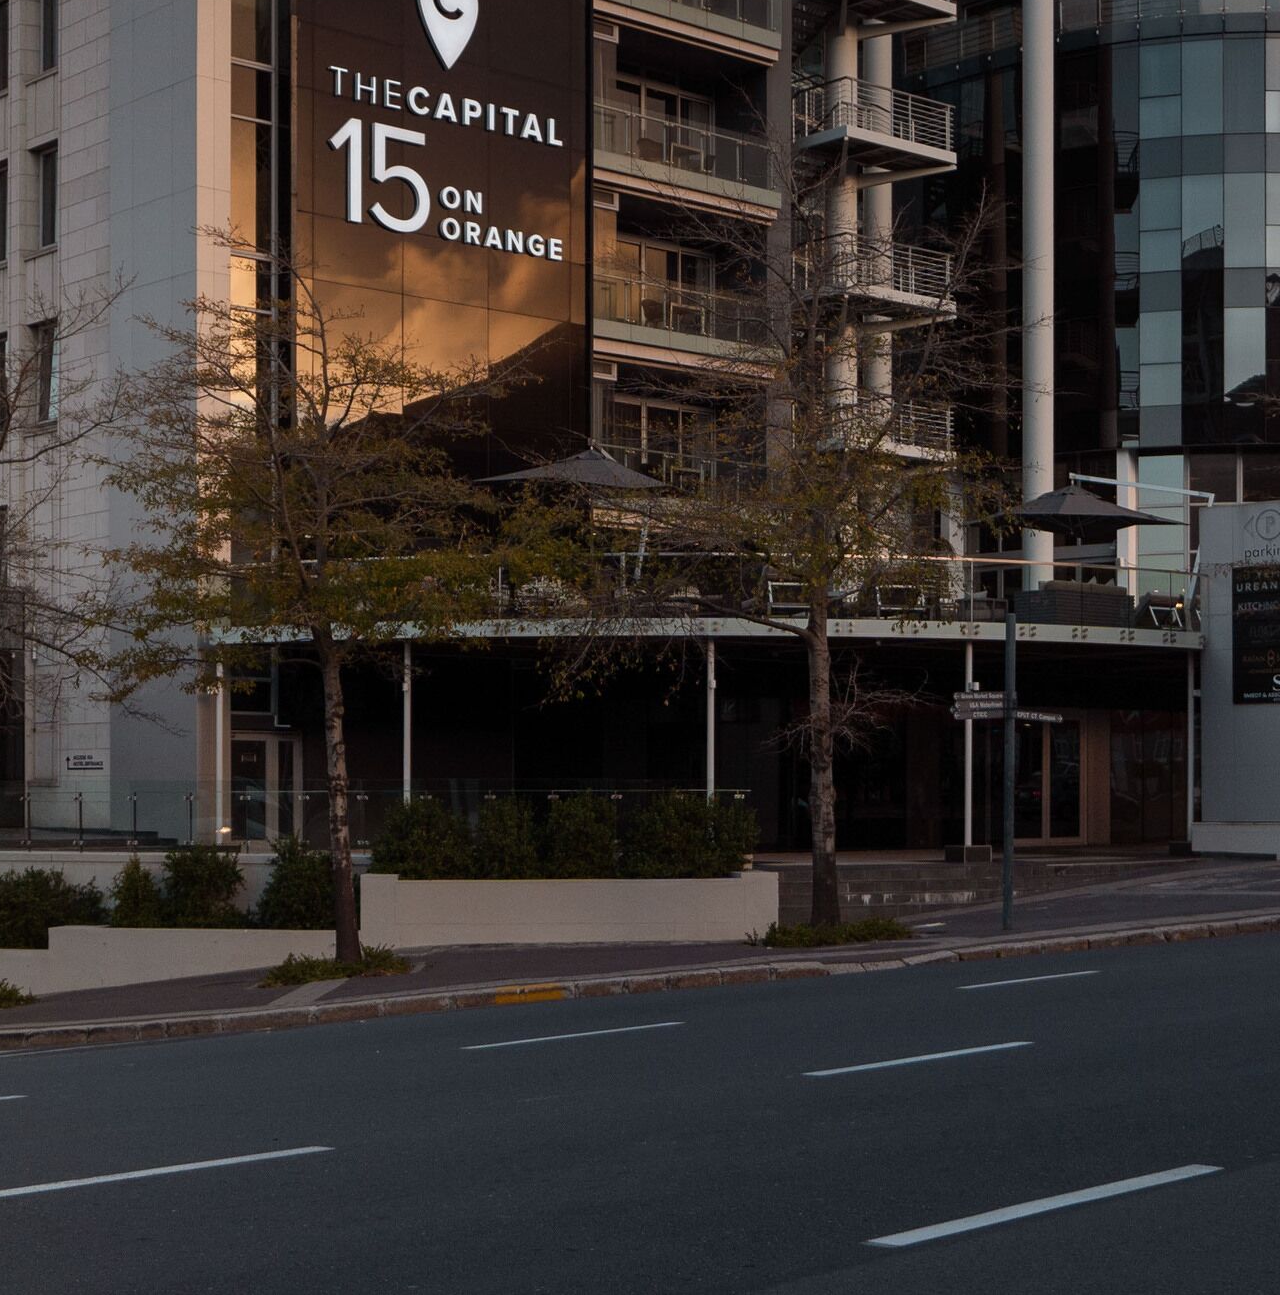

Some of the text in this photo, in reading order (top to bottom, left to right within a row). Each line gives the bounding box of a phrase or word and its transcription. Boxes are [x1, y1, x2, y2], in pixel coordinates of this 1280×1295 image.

[327, 118, 431, 233] 15
[439, 186, 483, 214] ON
[439, 218, 563, 261] ORANGE
[1236, 580, 1278, 593] URBAN
